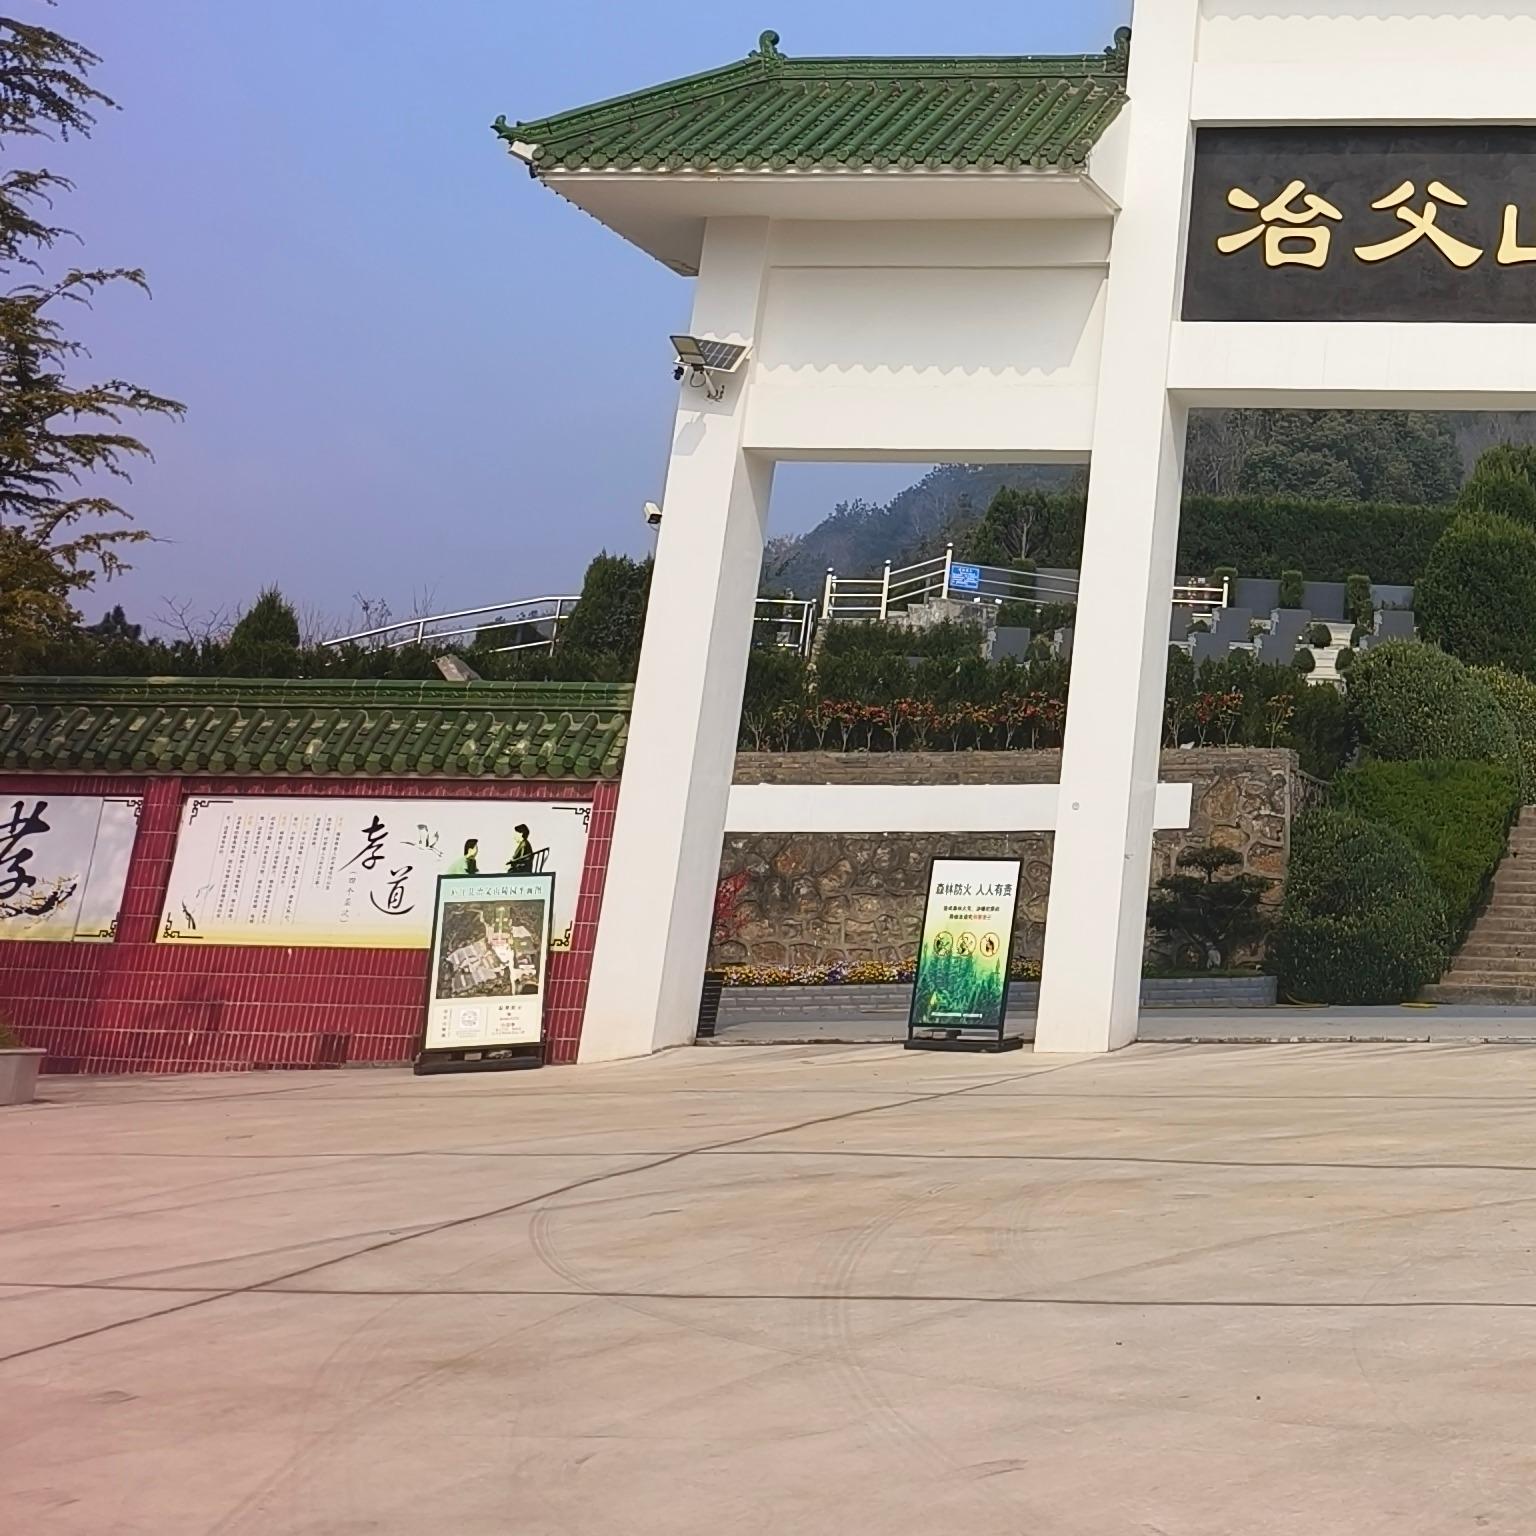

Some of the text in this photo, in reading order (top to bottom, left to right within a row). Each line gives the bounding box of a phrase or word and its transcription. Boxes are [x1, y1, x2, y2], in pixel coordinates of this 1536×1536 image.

[935, 882, 1013, 897] 森林防火 人人有责
